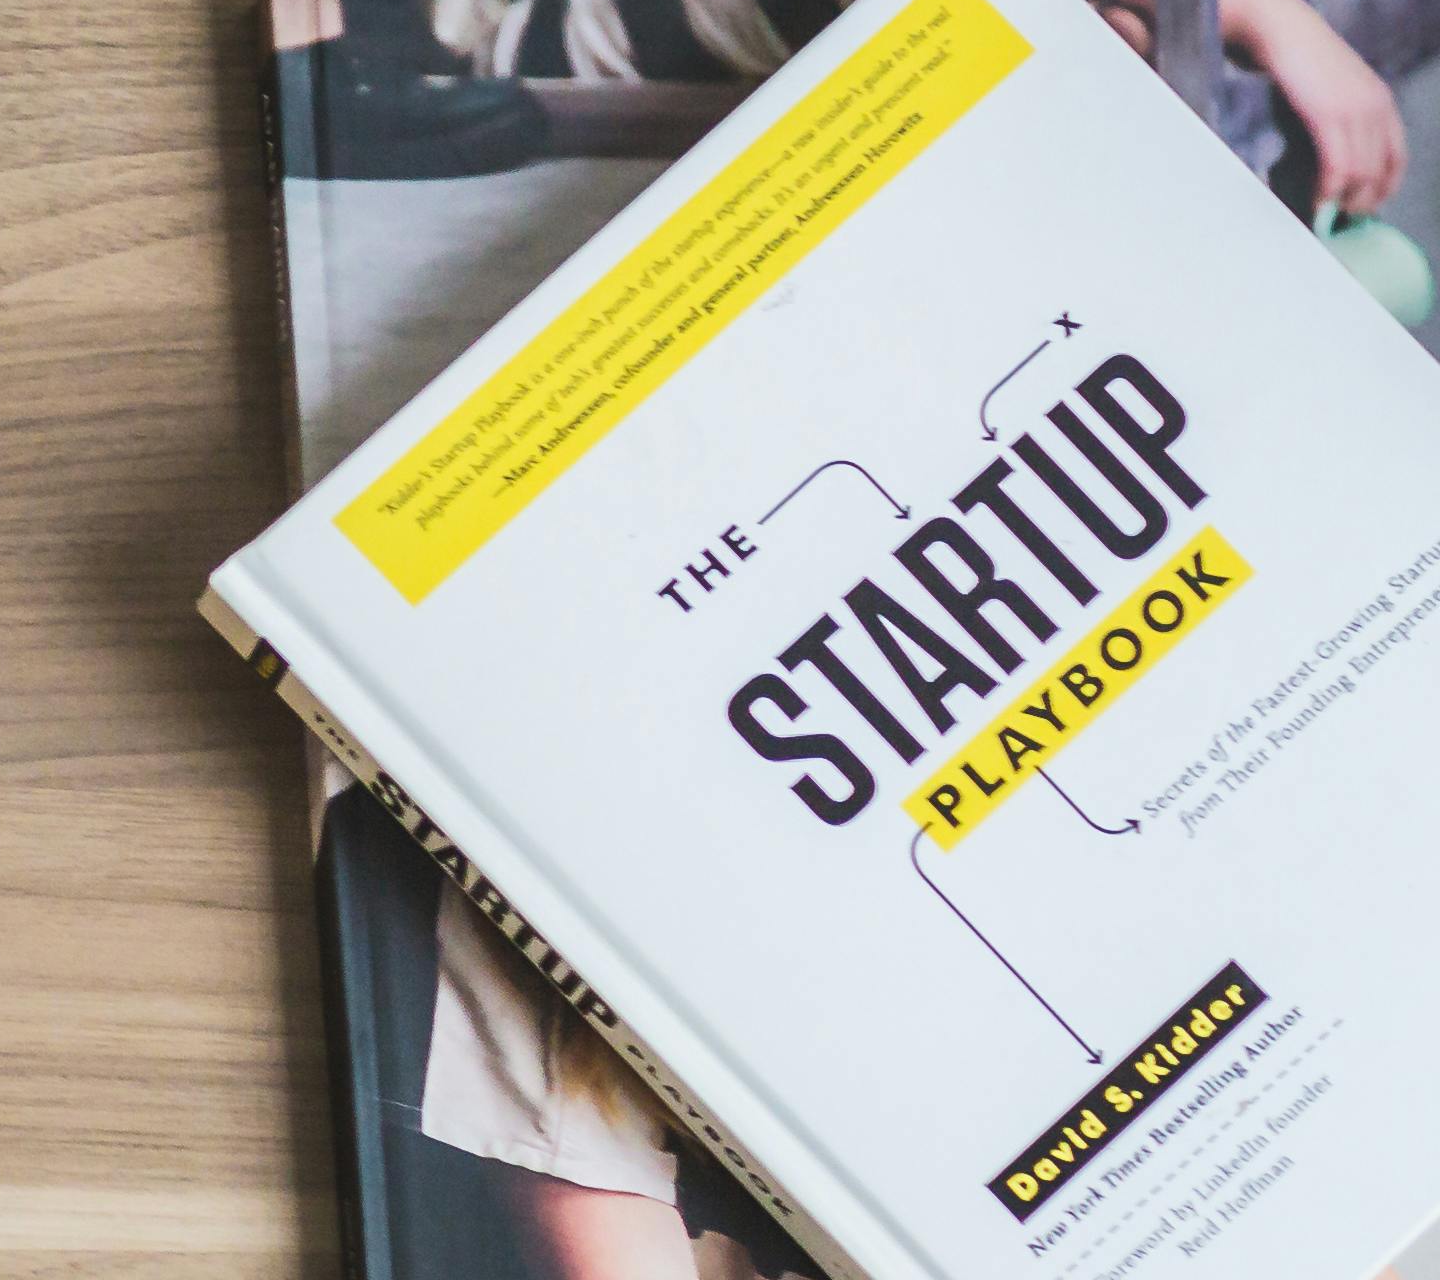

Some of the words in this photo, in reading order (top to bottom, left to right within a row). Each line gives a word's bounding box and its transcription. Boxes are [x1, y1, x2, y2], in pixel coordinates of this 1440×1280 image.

[428, 432, 479, 474] Startup
[472, 382, 533, 434] Playbook
[650, 256, 674, 276] the
[906, 28, 929, 49] the
[469, 434, 516, 477] behind
[688, 256, 714, 284] and
[848, 113, 875, 141] and
[676, 306, 703, 334] and
[700, 264, 749, 315] general
[657, 524, 758, 613] THE
[726, 353, 1209, 827] STARTUP
[926, 551, 1230, 828] PLAYBOOK
[1141, 761, 1208, 819] Secrets
[1207, 734, 1229, 763] of
[1224, 715, 1255, 744] the
[1250, 593, 1395, 718] Fastest-Growing
[1179, 792, 1224, 839] from
[1215, 748, 1270, 792] Their
[1265, 674, 1357, 750] Founding
[359, 771, 618, 1028] STARTUP
[1006, 1109, 1107, 1202] David
[1104, 1085, 1144, 1113] S.
[1134, 984, 1246, 1084] Kidder
[1026, 1221, 1067, 1258] New
[1064, 1186, 1105, 1222] York
[1099, 1145, 1153, 1189] Times
[1148, 1061, 1249, 1146] Bestselling
[1243, 1007, 1303, 1062] Author
[1168, 1200, 1199, 1222] by
[1191, 1134, 1270, 1201] LinkedIn
[1264, 1075, 1333, 1135] founder
[1176, 1217, 1222, 1258] Reid
[1215, 1155, 1295, 1223] Hoffman
